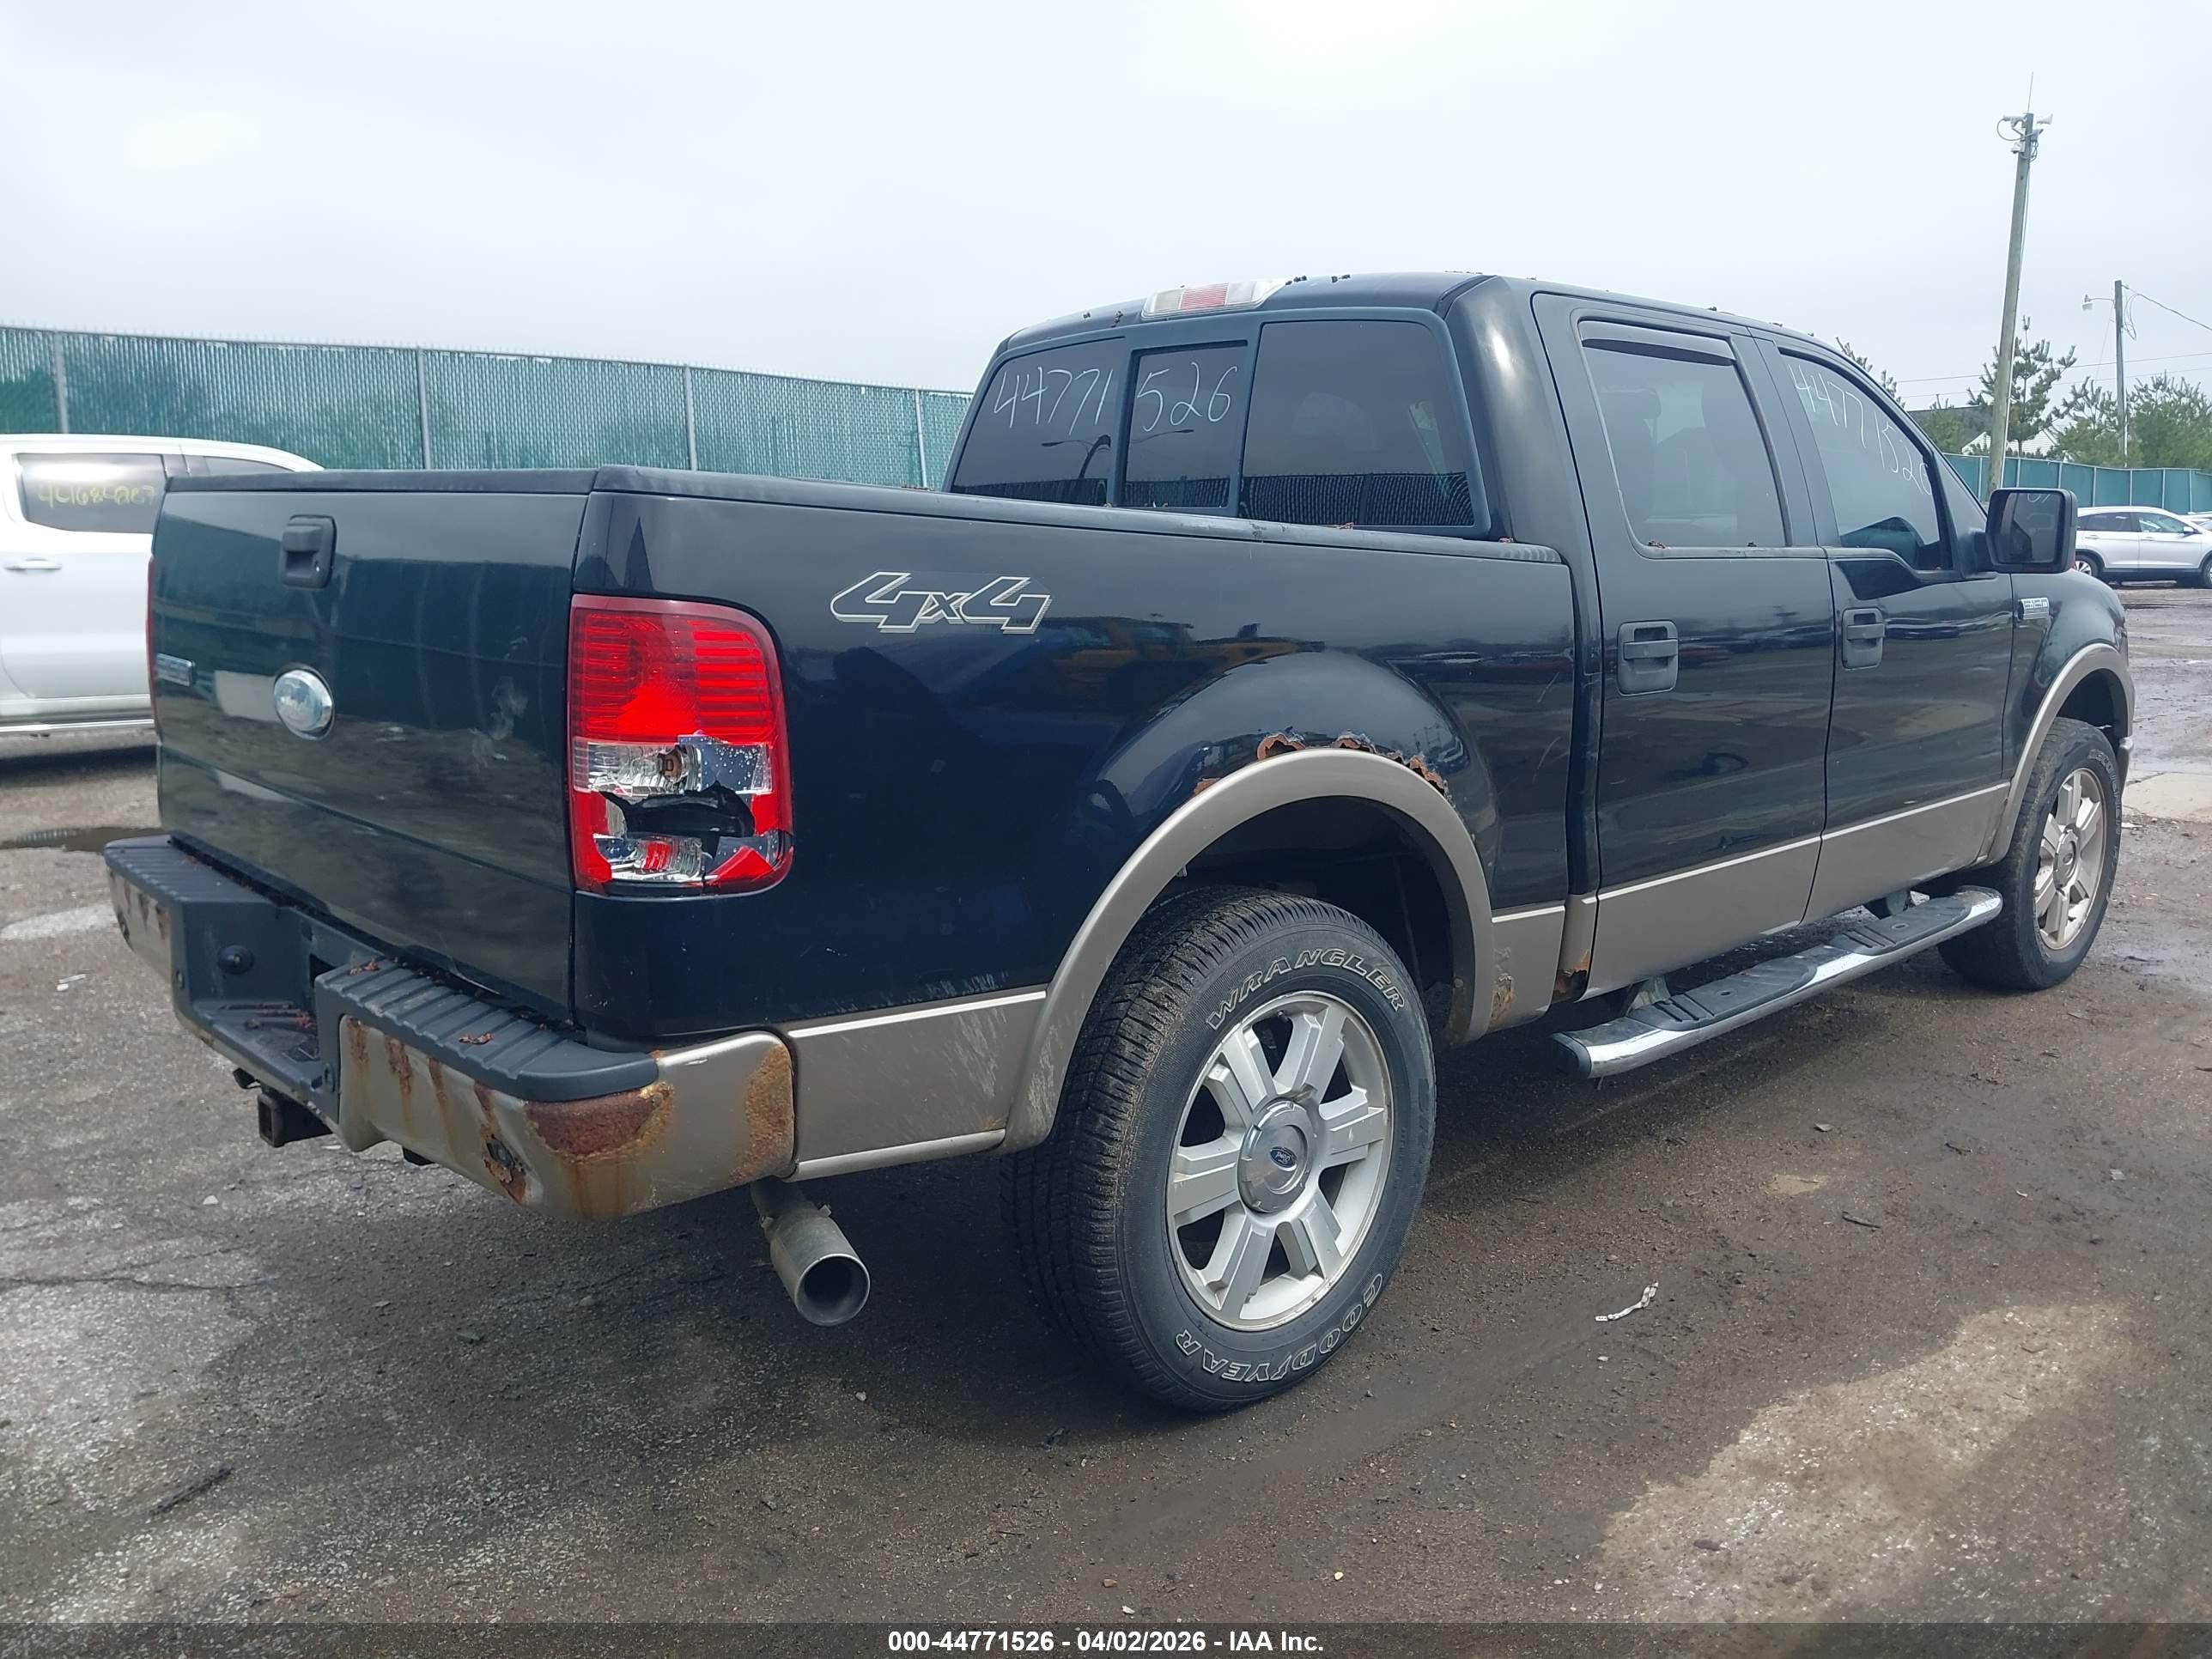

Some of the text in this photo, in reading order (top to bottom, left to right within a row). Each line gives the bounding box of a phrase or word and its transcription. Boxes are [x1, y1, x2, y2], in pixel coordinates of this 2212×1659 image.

[994, 362, 1237, 435] 44771 526
[830, 570, 1053, 635] 4x4
[1206, 948, 1405, 1030] WRANGLER
[1176, 1273, 1383, 1382] GOODYEAR
